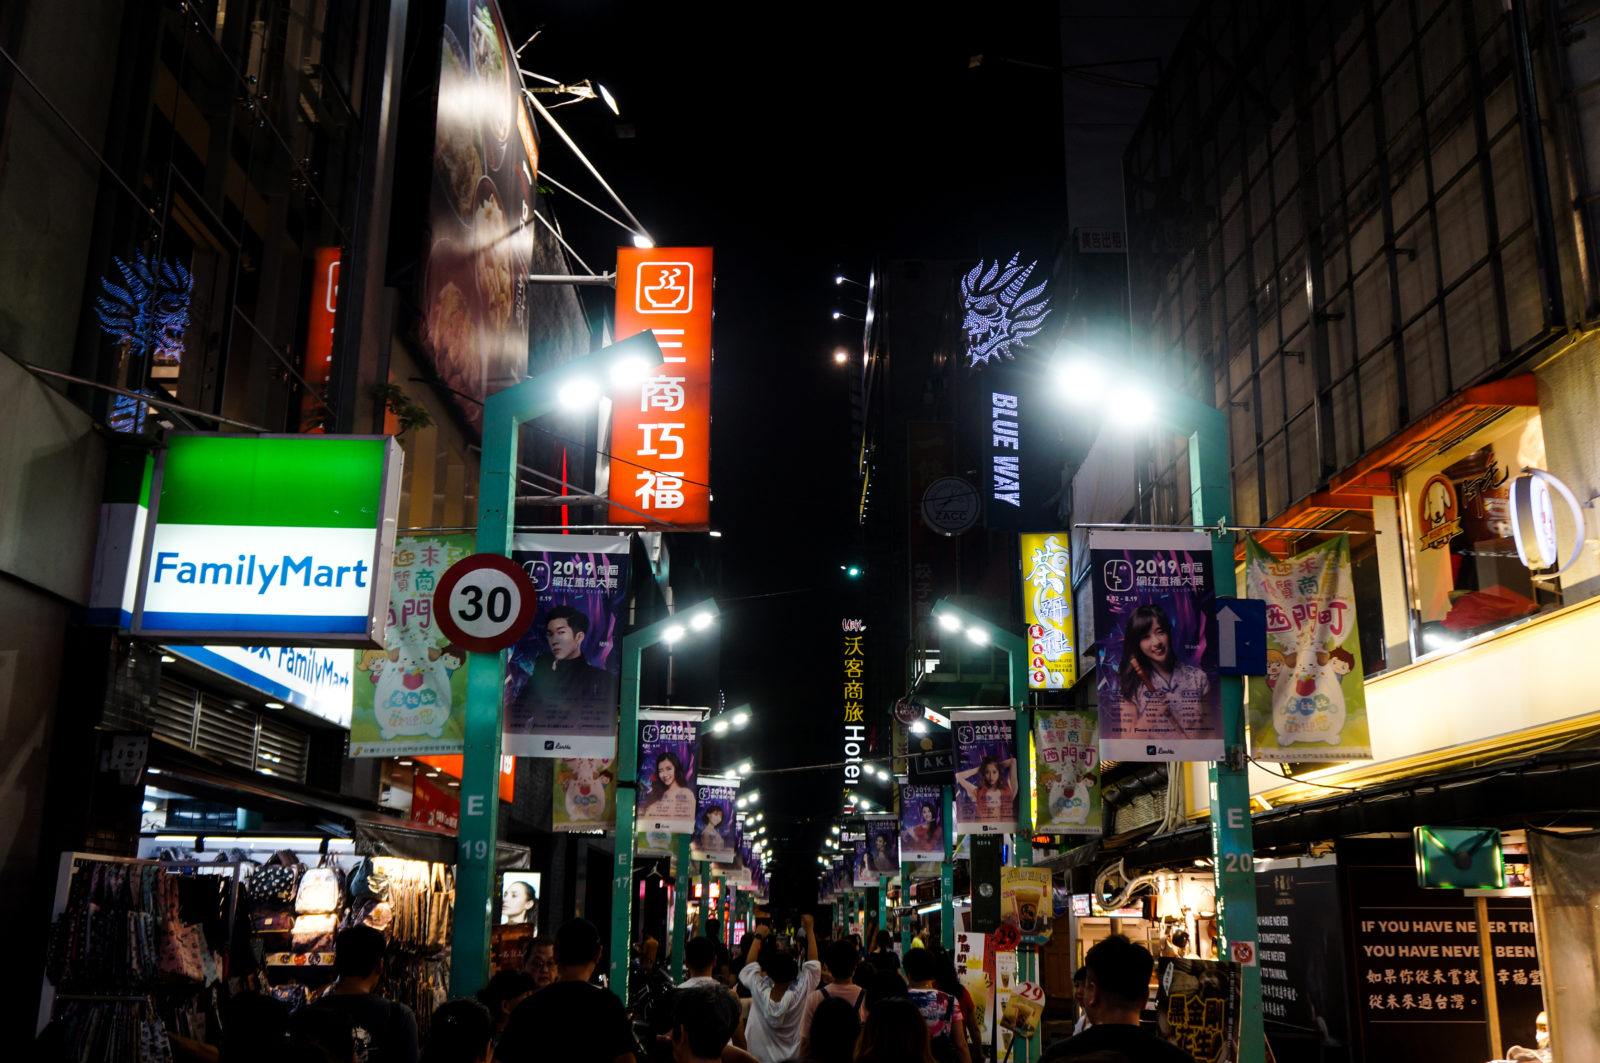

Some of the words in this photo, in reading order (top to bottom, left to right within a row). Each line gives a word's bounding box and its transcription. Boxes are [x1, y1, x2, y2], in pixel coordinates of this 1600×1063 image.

[635, 329, 687, 510] 三商巧福
[992, 392, 1019, 451] BLUE
[993, 455, 1020, 507] WAY
[154, 552, 368, 595] FamilyMart
[553, 561, 594, 576] 2019
[1135, 560, 1176, 574] 2019
[458, 585, 512, 622] 30
[844, 636, 865, 722] 沃客商旅
[975, 725, 998, 734] 2019
[844, 725, 865, 784] Hotel
[1043, 746, 1096, 767] 西門町
[467, 795, 484, 816] E
[1228, 808, 1244, 828] E
[462, 840, 487, 860] 19
[619, 853, 627, 865] E
[1225, 853, 1251, 872] 20
[616, 877, 629, 888] 17
[1361, 921, 1375, 932] IF
[1378, 921, 1409, 932] YOU
[1413, 921, 1452, 932] HAVE
[1456, 921, 1506, 933] NEER
[1364, 946, 1395, 957] YOU
[1399, 946, 1438, 957] HAVE
[1442, 946, 1481, 957] NEVE
[1496, 946, 1535, 958] BEEN
[1020, 982, 1043, 1000] 29
